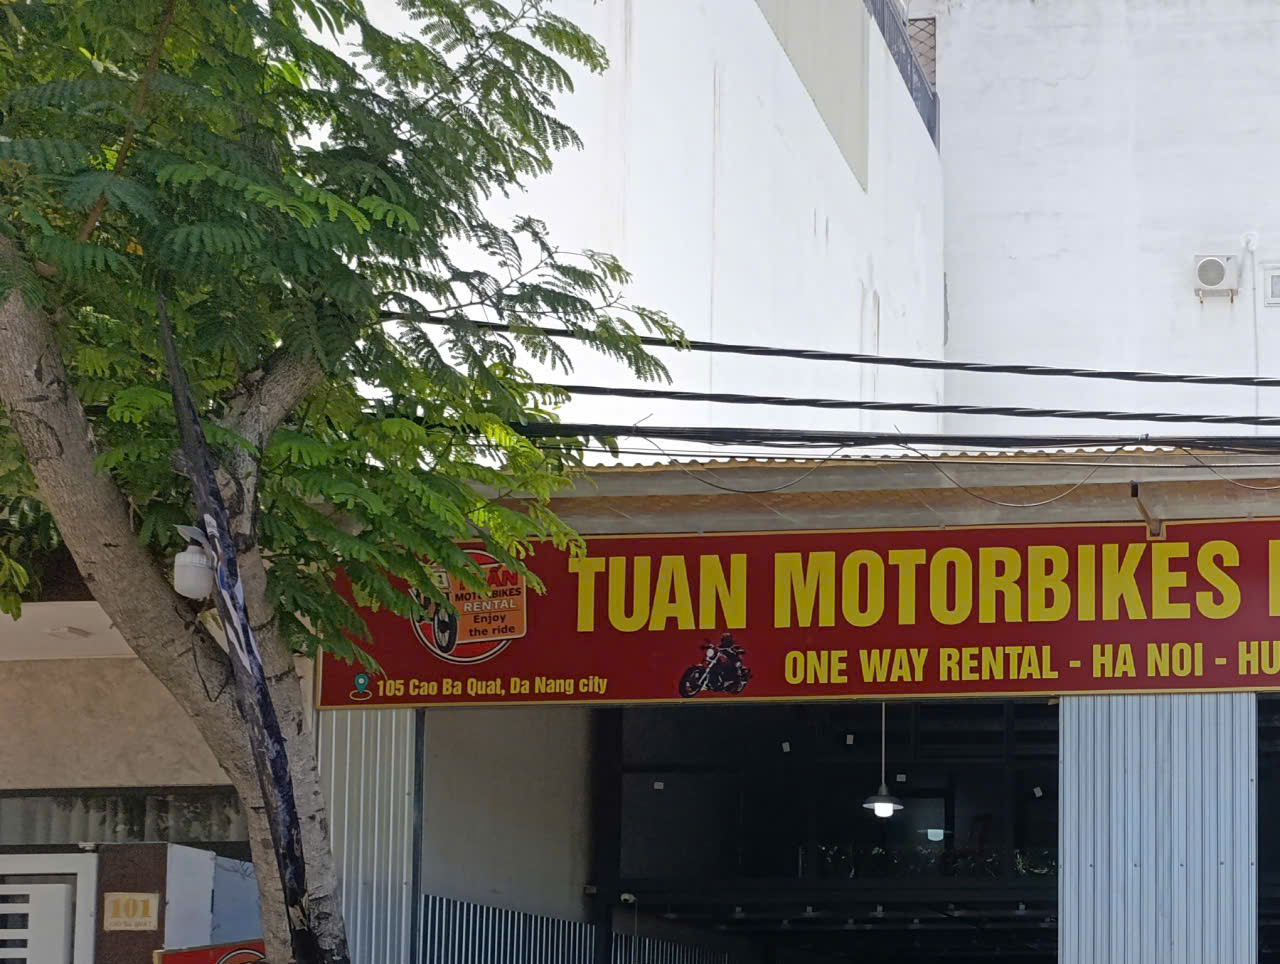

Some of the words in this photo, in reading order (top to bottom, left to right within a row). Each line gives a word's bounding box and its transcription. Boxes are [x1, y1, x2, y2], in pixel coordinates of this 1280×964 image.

[568, 553, 747, 632] TUAN
[774, 539, 1242, 629] MOTORBIKES
[455, 587, 521, 602] MOTBIKES
[463, 599, 517, 612] RENTAL
[473, 614, 506, 625] Enjoy
[469, 627, 488, 637] the
[492, 625, 515, 635] ride
[785, 650, 848, 684] ONE
[859, 648, 929, 683] WAY
[939, 645, 1059, 681] RENTAL
[1092, 644, 1136, 678] HA
[1147, 642, 1203, 677] NOI
[377, 679, 405, 697] 105
[409, 678, 438, 696] Cao
[442, 678, 462, 695] Ba
[510, 676, 530, 694] Da
[534, 675, 574, 695] Nang
[579, 675, 608, 694] city
[112, 899, 152, 918] 101
